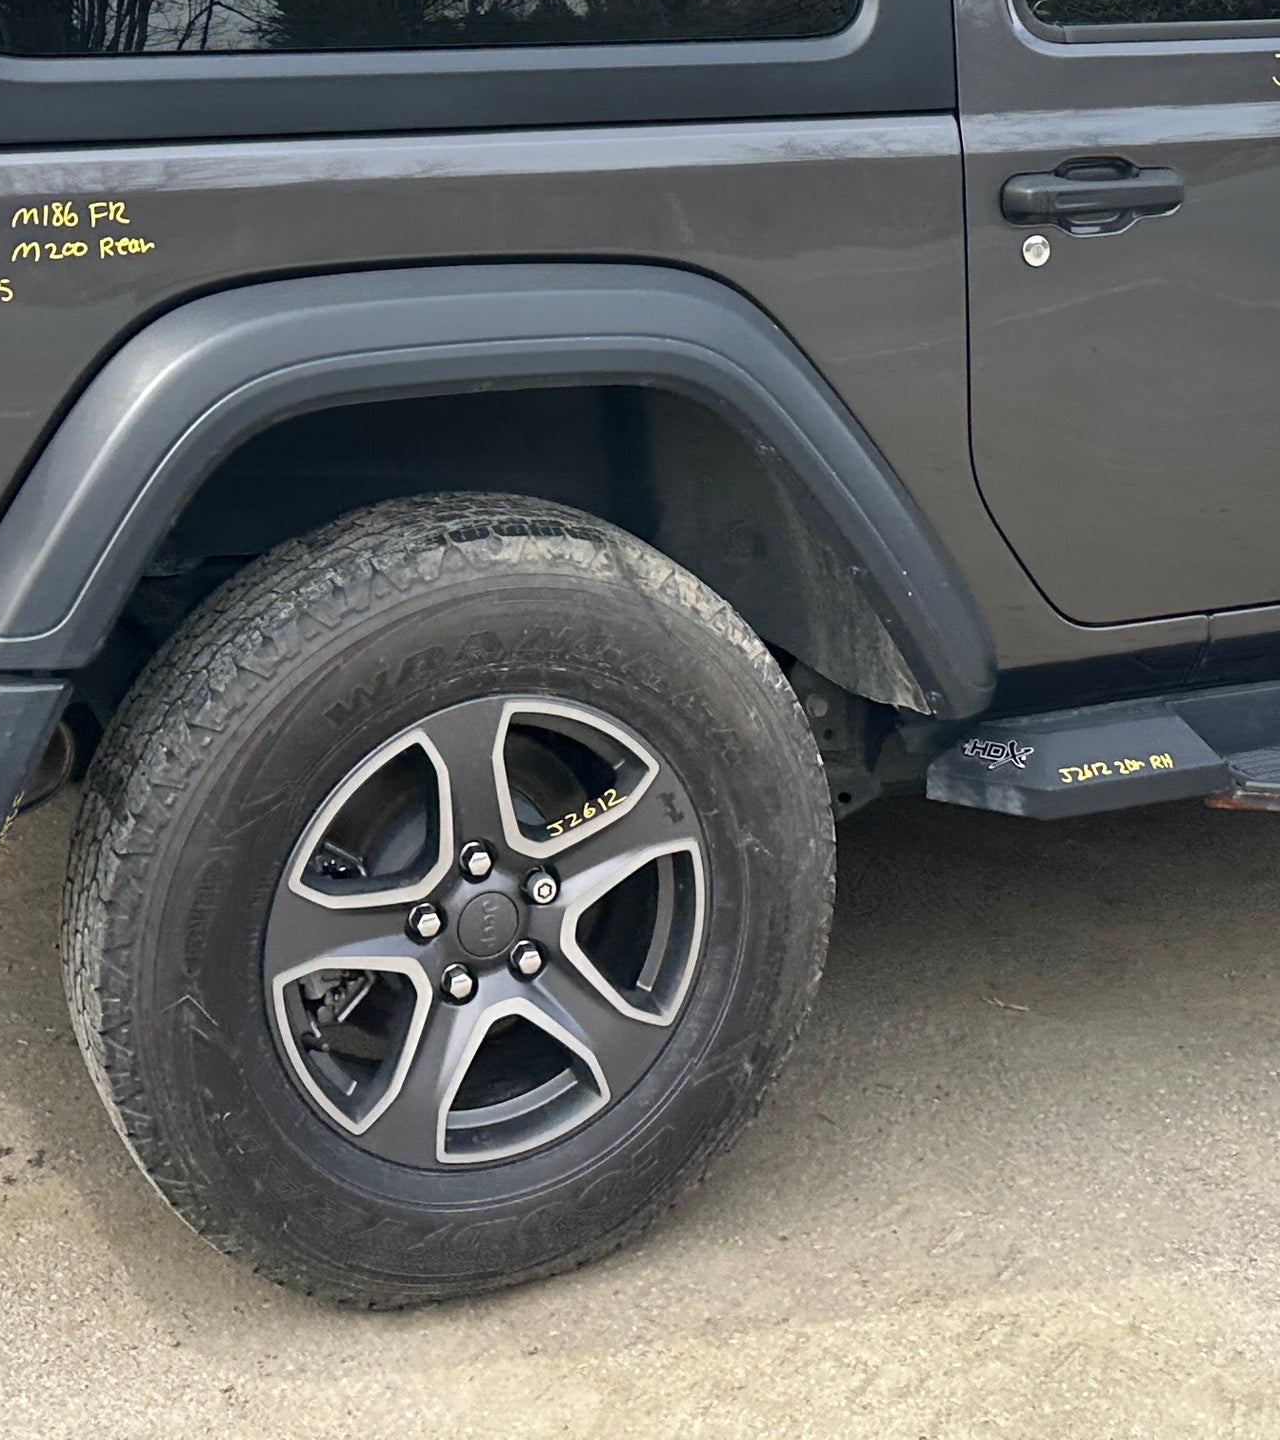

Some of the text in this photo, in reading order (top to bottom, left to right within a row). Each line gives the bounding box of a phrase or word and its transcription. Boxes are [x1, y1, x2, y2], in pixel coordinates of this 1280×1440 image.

[88, 201, 131, 229] FR
[99, 236, 156, 260] Rear
[963, 738, 1035, 771] HDX
[1058, 762, 1112, 784] J2612
[1148, 752, 1174, 770] RH
[546, 788, 628, 838] J2612
